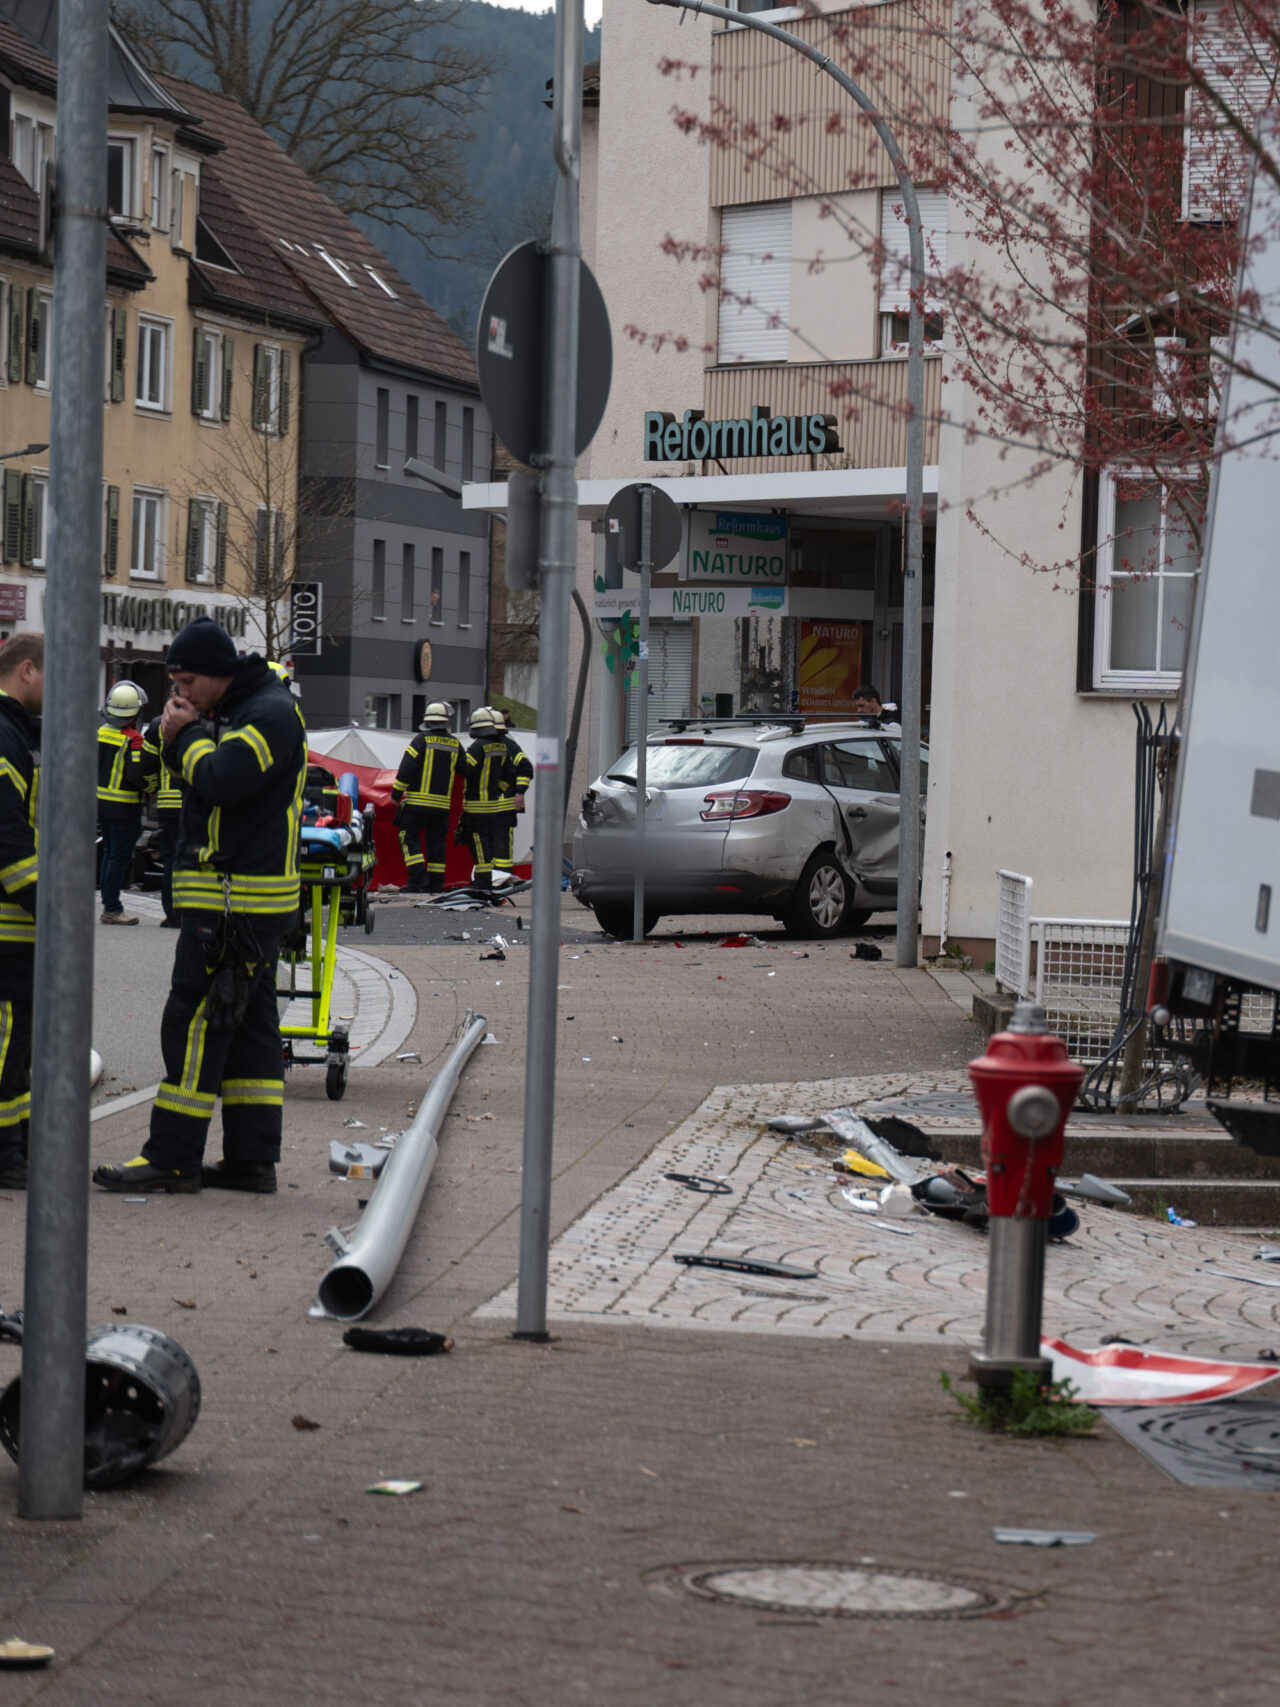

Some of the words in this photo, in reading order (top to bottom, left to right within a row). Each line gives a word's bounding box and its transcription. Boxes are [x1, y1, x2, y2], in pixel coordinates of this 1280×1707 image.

[644, 405, 828, 461] Reformhaus
[718, 517, 782, 536] Reformhaus
[292, 592, 317, 643] TOTO
